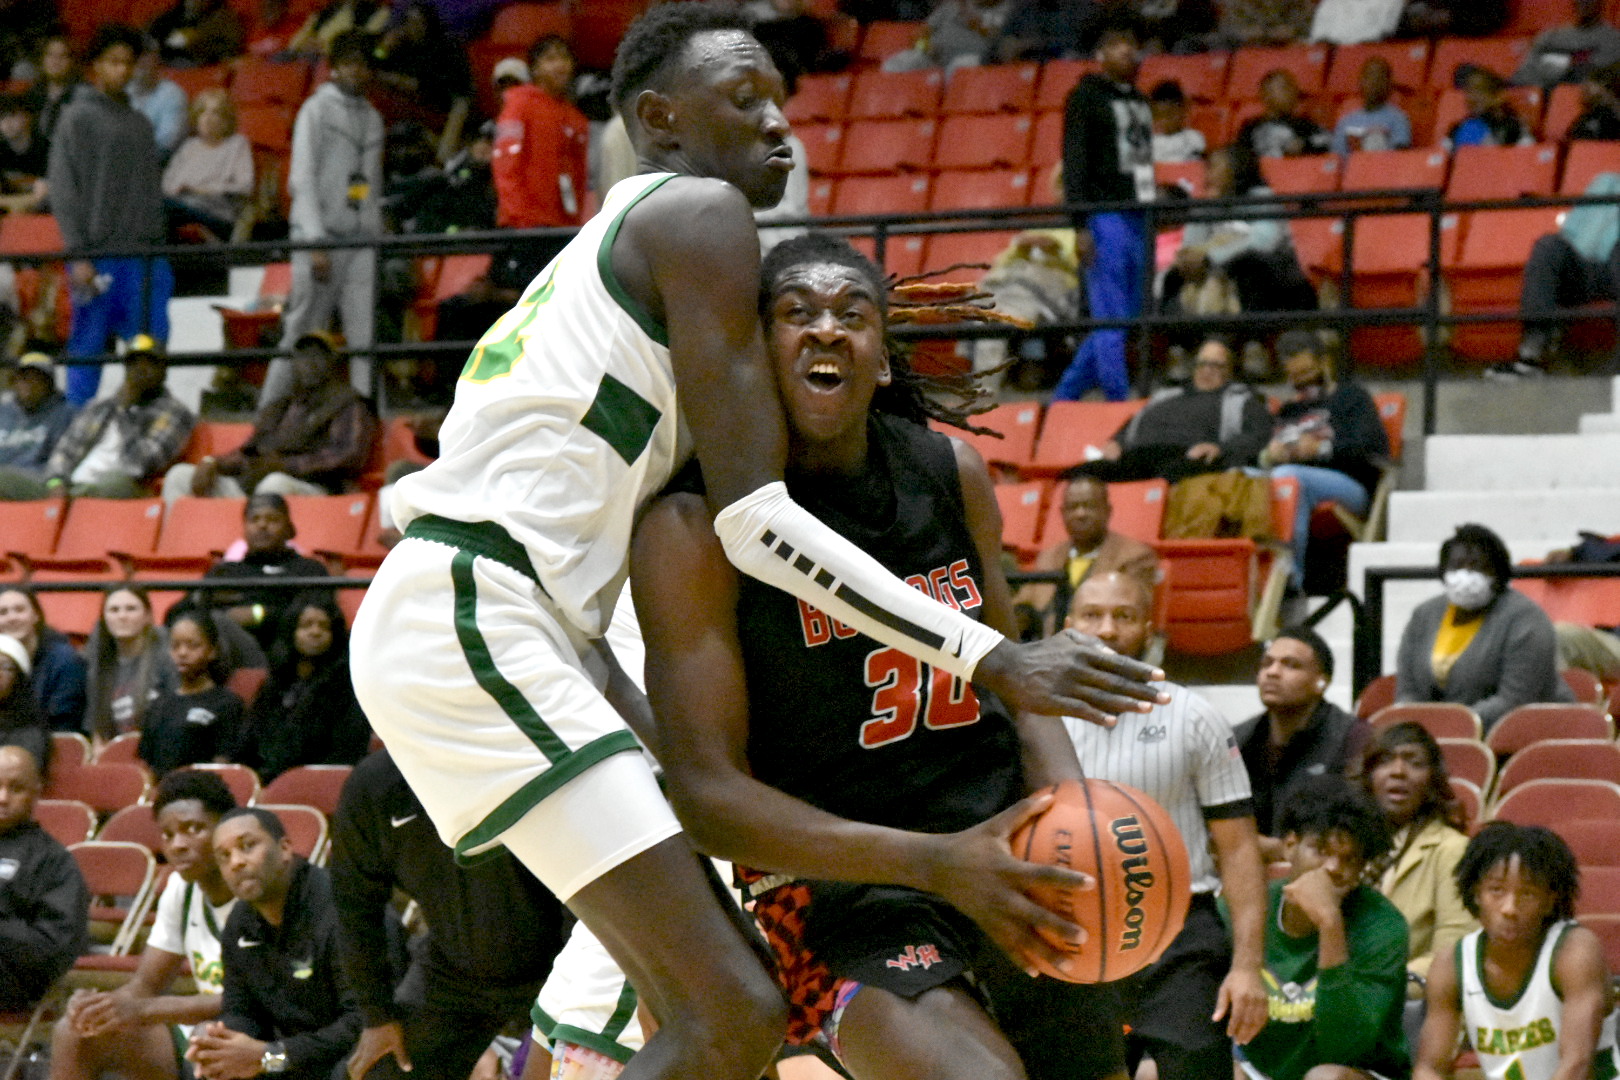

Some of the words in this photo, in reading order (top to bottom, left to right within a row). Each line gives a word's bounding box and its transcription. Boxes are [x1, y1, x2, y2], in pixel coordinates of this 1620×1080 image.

[797, 558, 983, 648] BOGS
[859, 647, 981, 749] 30
[1108, 813, 1155, 952] Wilson
